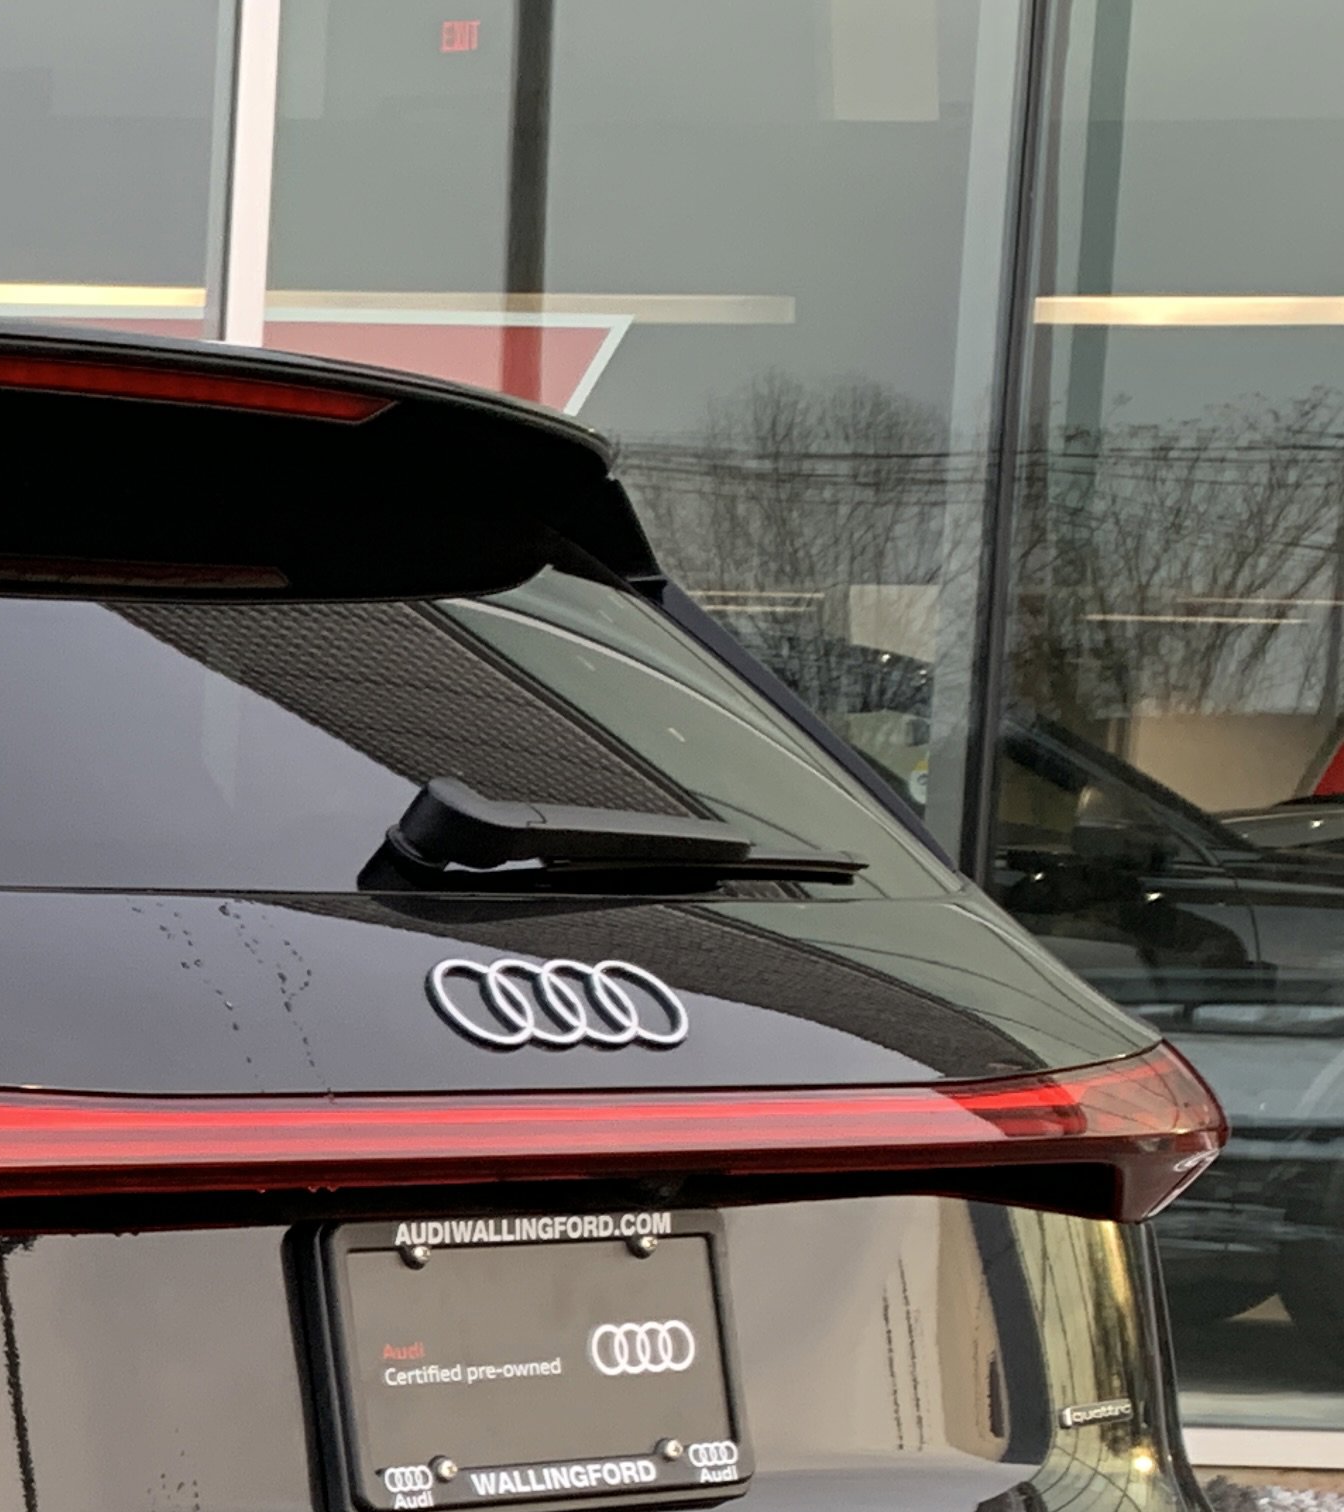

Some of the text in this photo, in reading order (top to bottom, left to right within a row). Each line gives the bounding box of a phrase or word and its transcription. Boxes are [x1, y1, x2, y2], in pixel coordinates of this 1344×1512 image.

[394, 1212, 672, 1246] AUDIWALLINGFORD.COM
[383, 1341, 425, 1360] Audi
[384, 1357, 563, 1386] Certified pre-owned
[470, 1459, 657, 1496] WALLINGFORD
[699, 1465, 739, 1484] Audi
[393, 1490, 435, 1510] Audi
